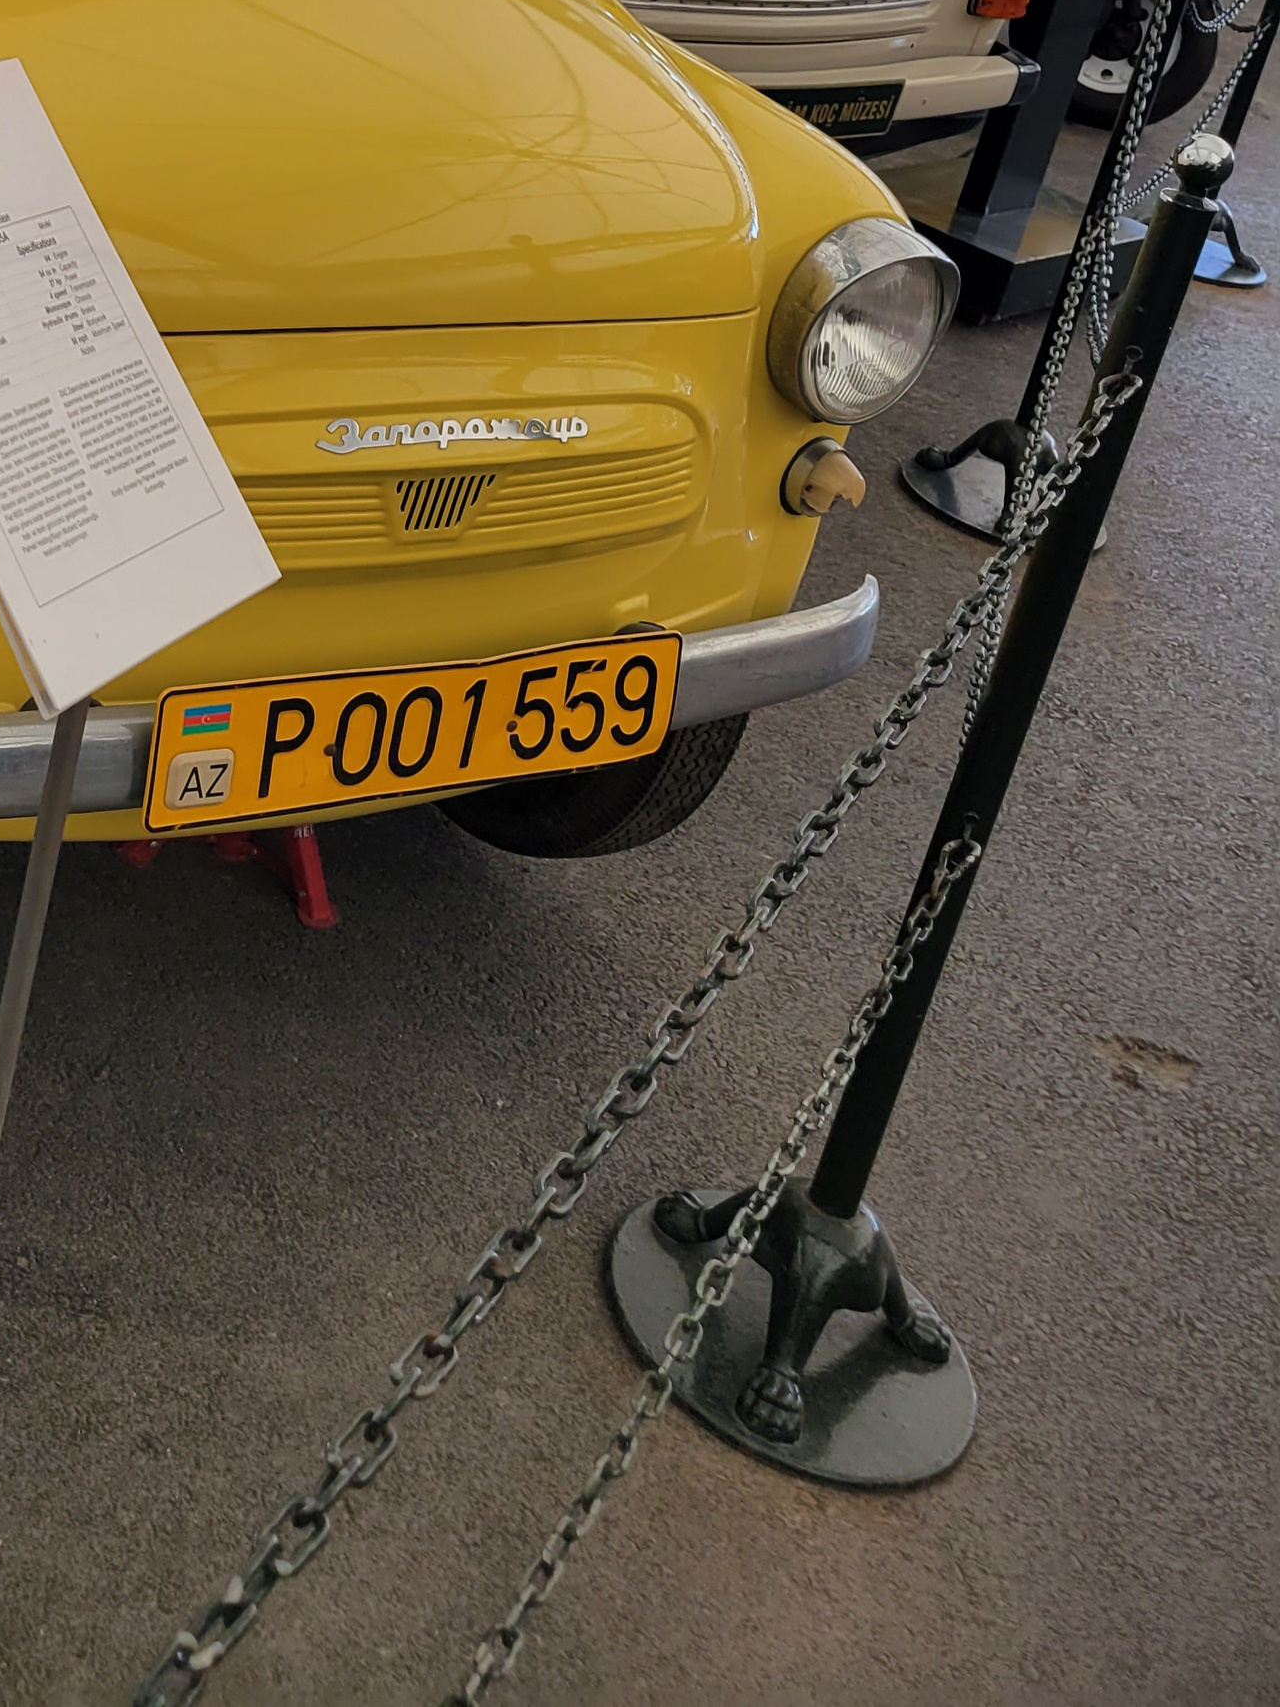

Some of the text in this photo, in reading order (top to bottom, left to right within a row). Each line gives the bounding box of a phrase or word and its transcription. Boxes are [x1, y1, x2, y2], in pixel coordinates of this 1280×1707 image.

[809, 104, 839, 127] KOÇ
[839, 95, 895, 122] MÜZESİ
[257, 654, 658, 798] P 001 559
[179, 764, 229, 801] AZ
